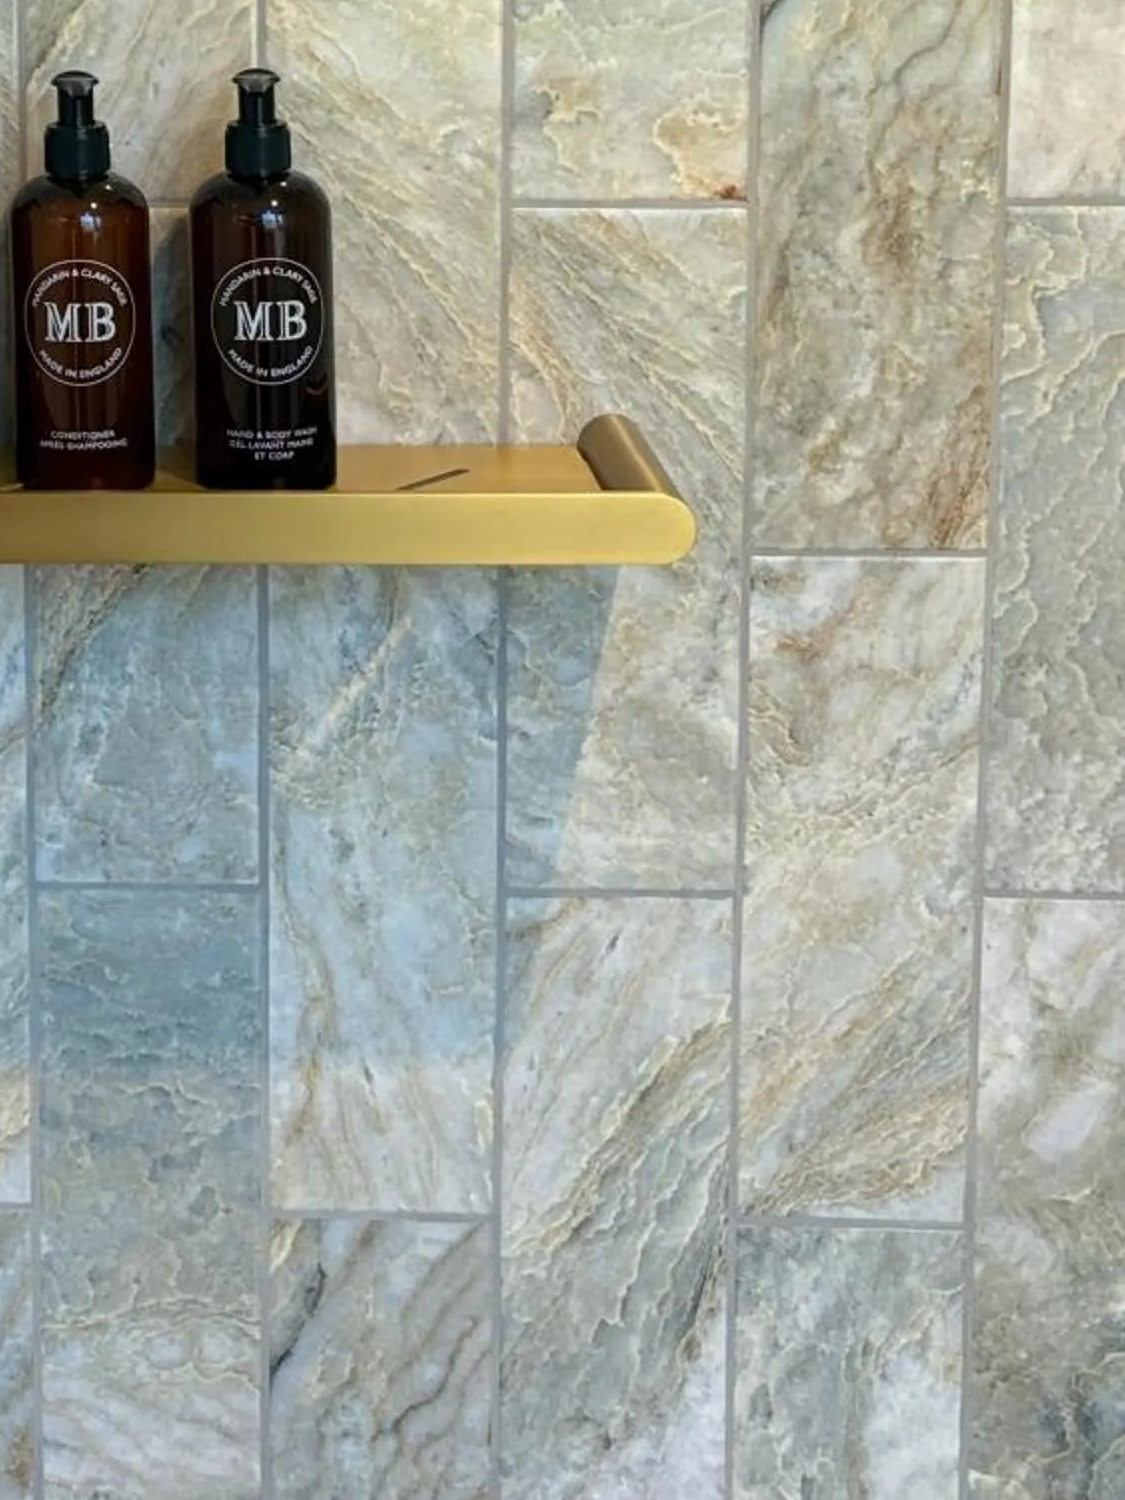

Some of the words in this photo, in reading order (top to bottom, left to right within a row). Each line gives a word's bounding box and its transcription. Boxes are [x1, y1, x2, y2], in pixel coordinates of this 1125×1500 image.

[31, 270, 70, 308] MANDARIN
[71, 268, 79, 277] &
[80, 268, 111, 285] CLARY
[219, 267, 262, 307] MANDARIN
[262, 266, 271, 275] &
[272, 265, 303, 284] CLARY
[43, 301, 116, 343] MB
[233, 300, 308, 341] MB
[38, 349, 64, 374] MADE
[65, 367, 77, 378] IN
[78, 347, 122, 379] ENGLAND
[227, 348, 254, 373] MADE
[256, 367, 268, 377] IN
[270, 345, 314, 378] ENGLAND
[50, 429, 116, 440] CONDITIONER
